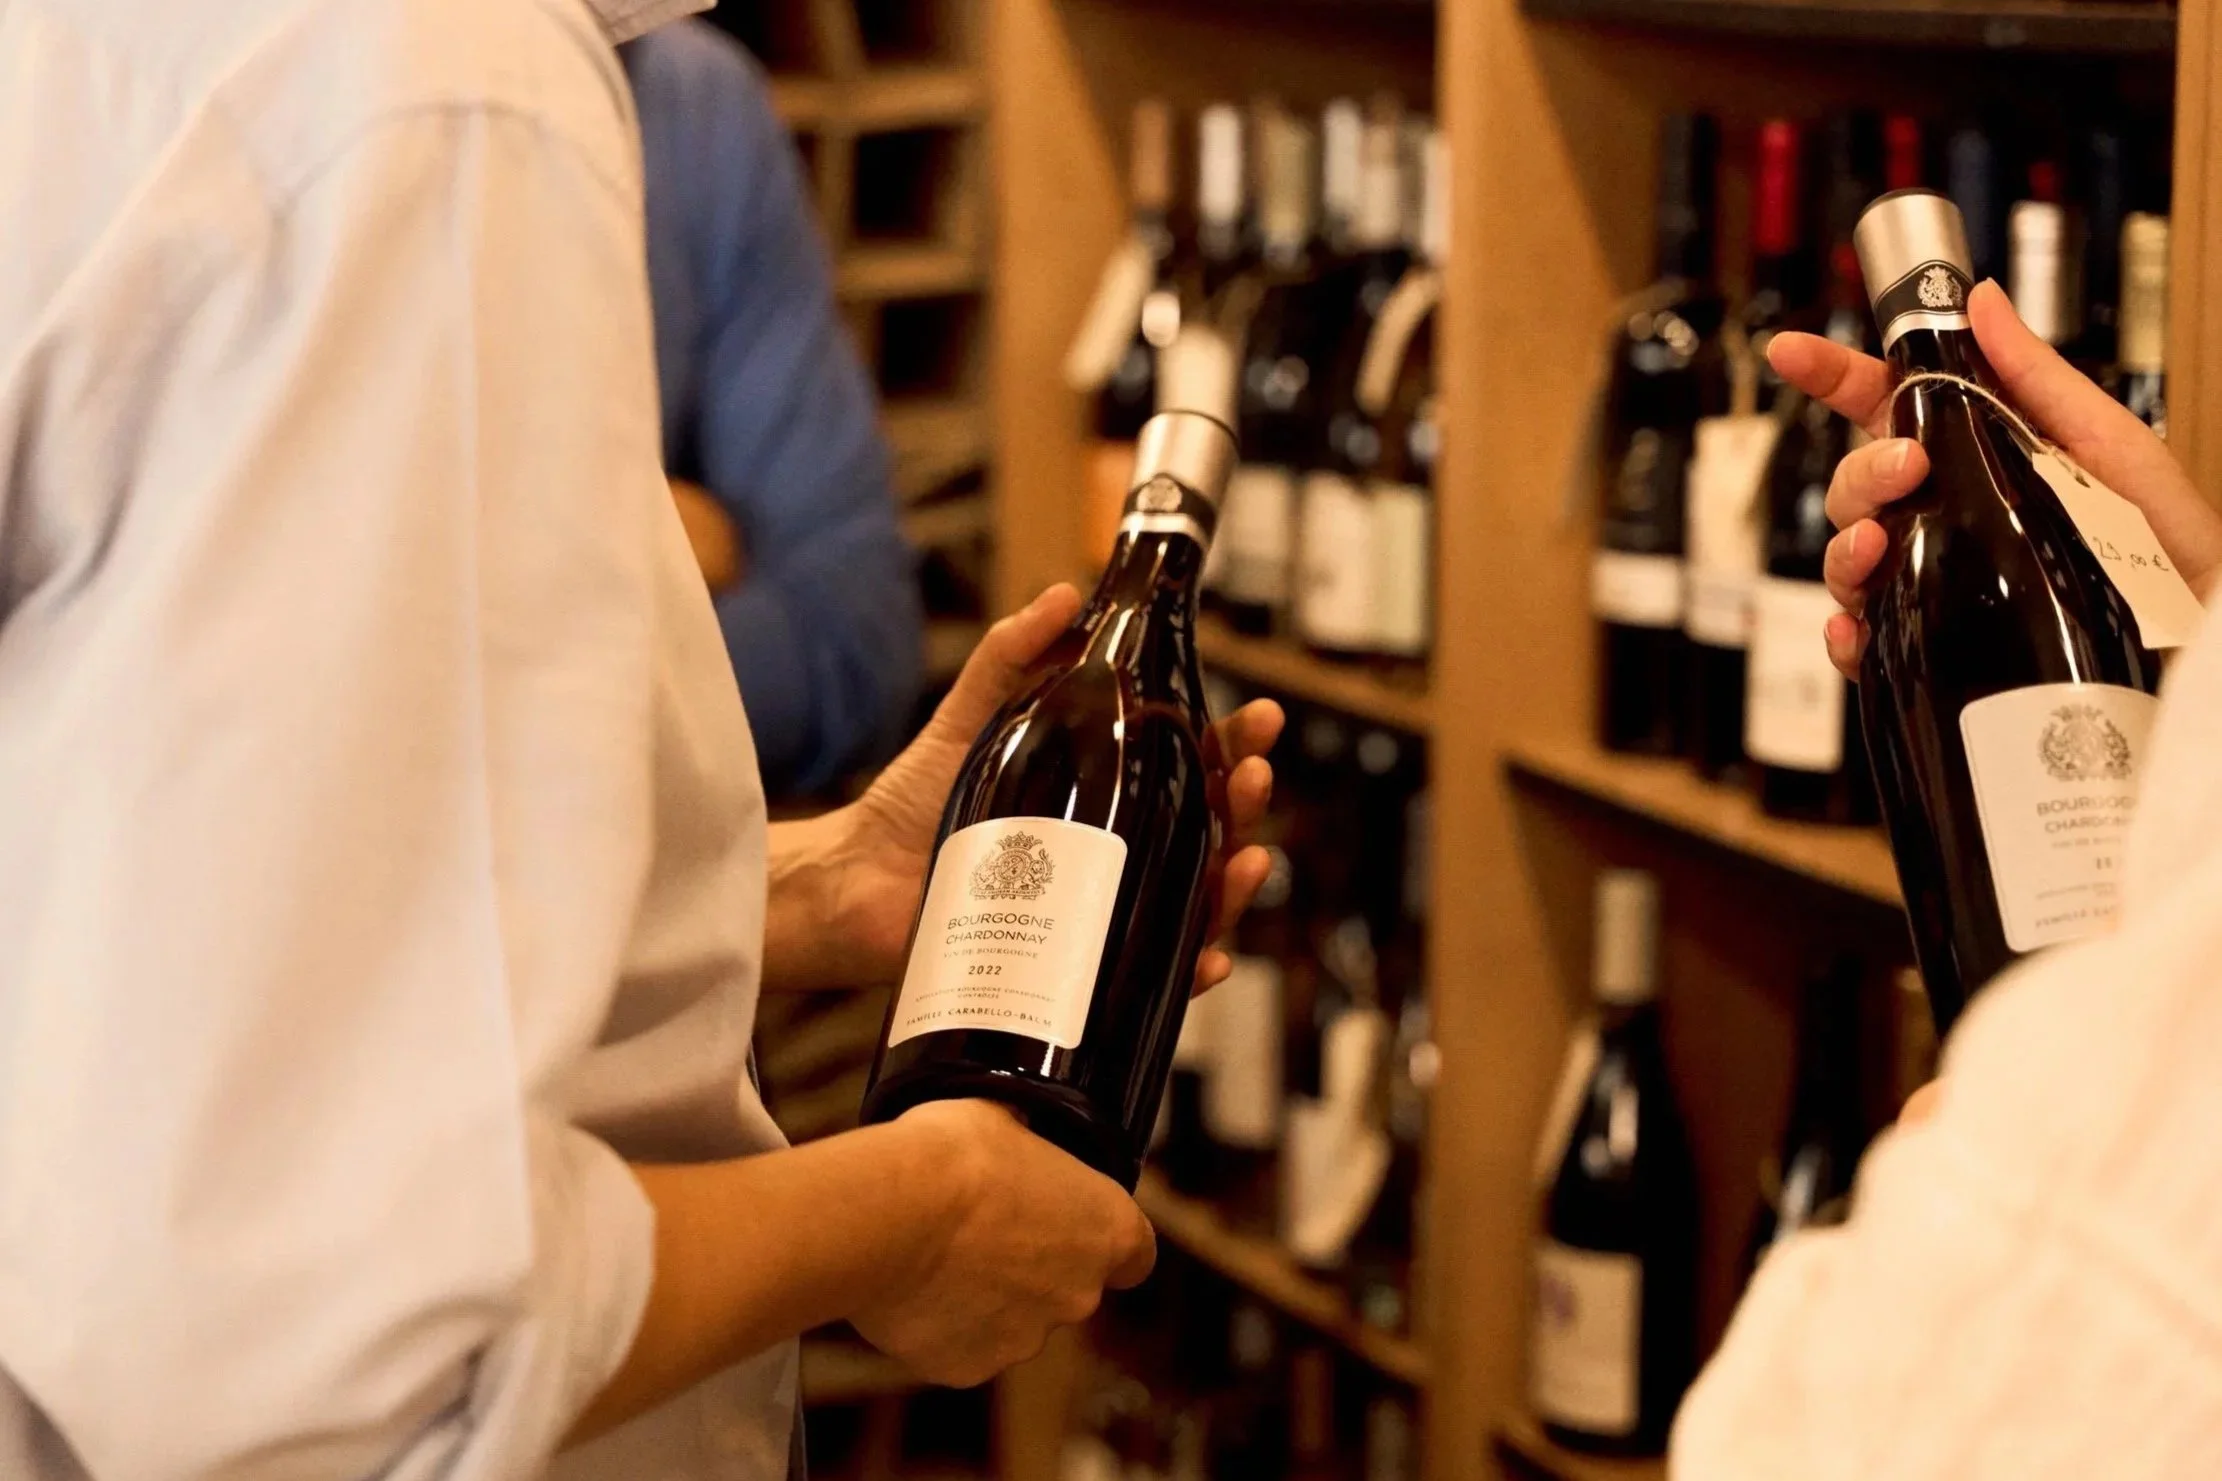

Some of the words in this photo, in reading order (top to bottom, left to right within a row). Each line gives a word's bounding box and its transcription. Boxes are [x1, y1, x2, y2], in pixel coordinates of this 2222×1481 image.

[2036, 796, 2138, 817] BOURGOG
[948, 912, 1055, 929] BOURGOGNE
[946, 930, 1047, 945] CHARDONNAY
[976, 947, 1039, 959] BOURGOGNE
[968, 965, 1002, 975] 2022
